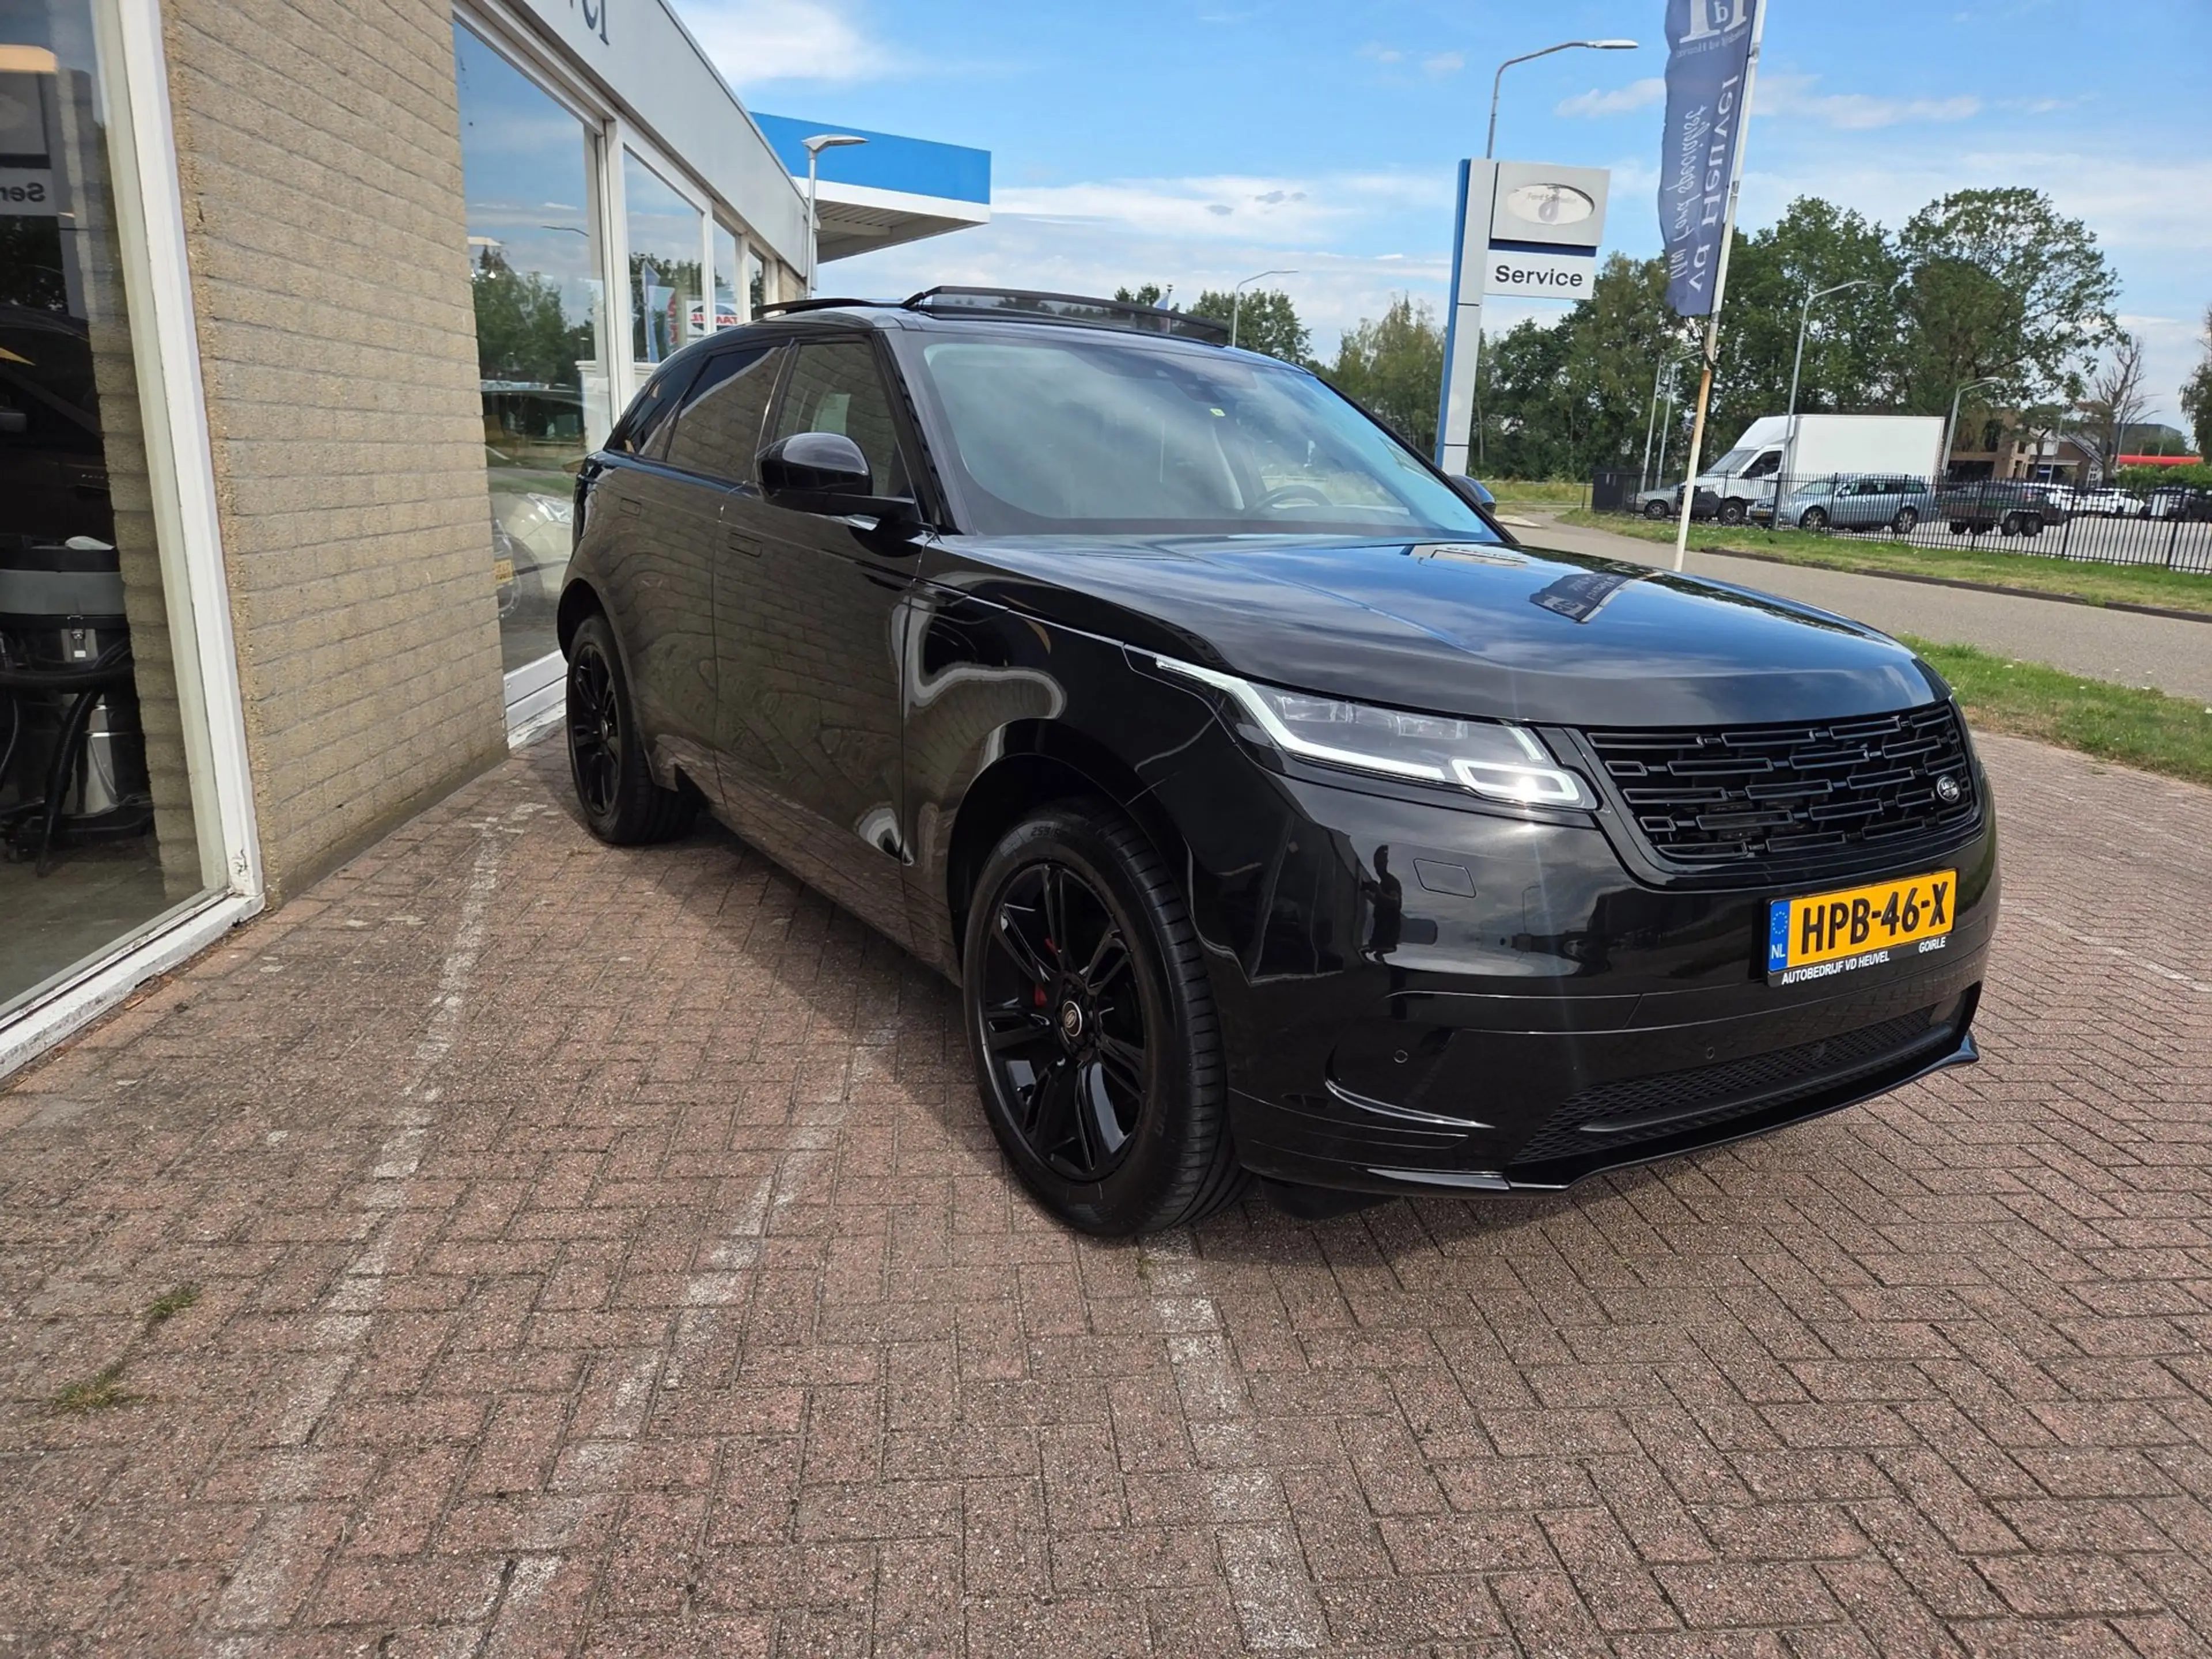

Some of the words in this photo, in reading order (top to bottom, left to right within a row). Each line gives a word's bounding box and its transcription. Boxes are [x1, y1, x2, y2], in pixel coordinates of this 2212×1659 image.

[1495, 264, 1583, 287] Service
[1801, 881, 1948, 956] HPB-46-X
[1771, 943, 1786, 960] NL
[1781, 961, 1843, 986] AUTOBEDRIJF
[1845, 957, 1858, 971] VD
[1858, 950, 1890, 969] HEUVEL
[1918, 936, 1946, 954] GOIRLE
